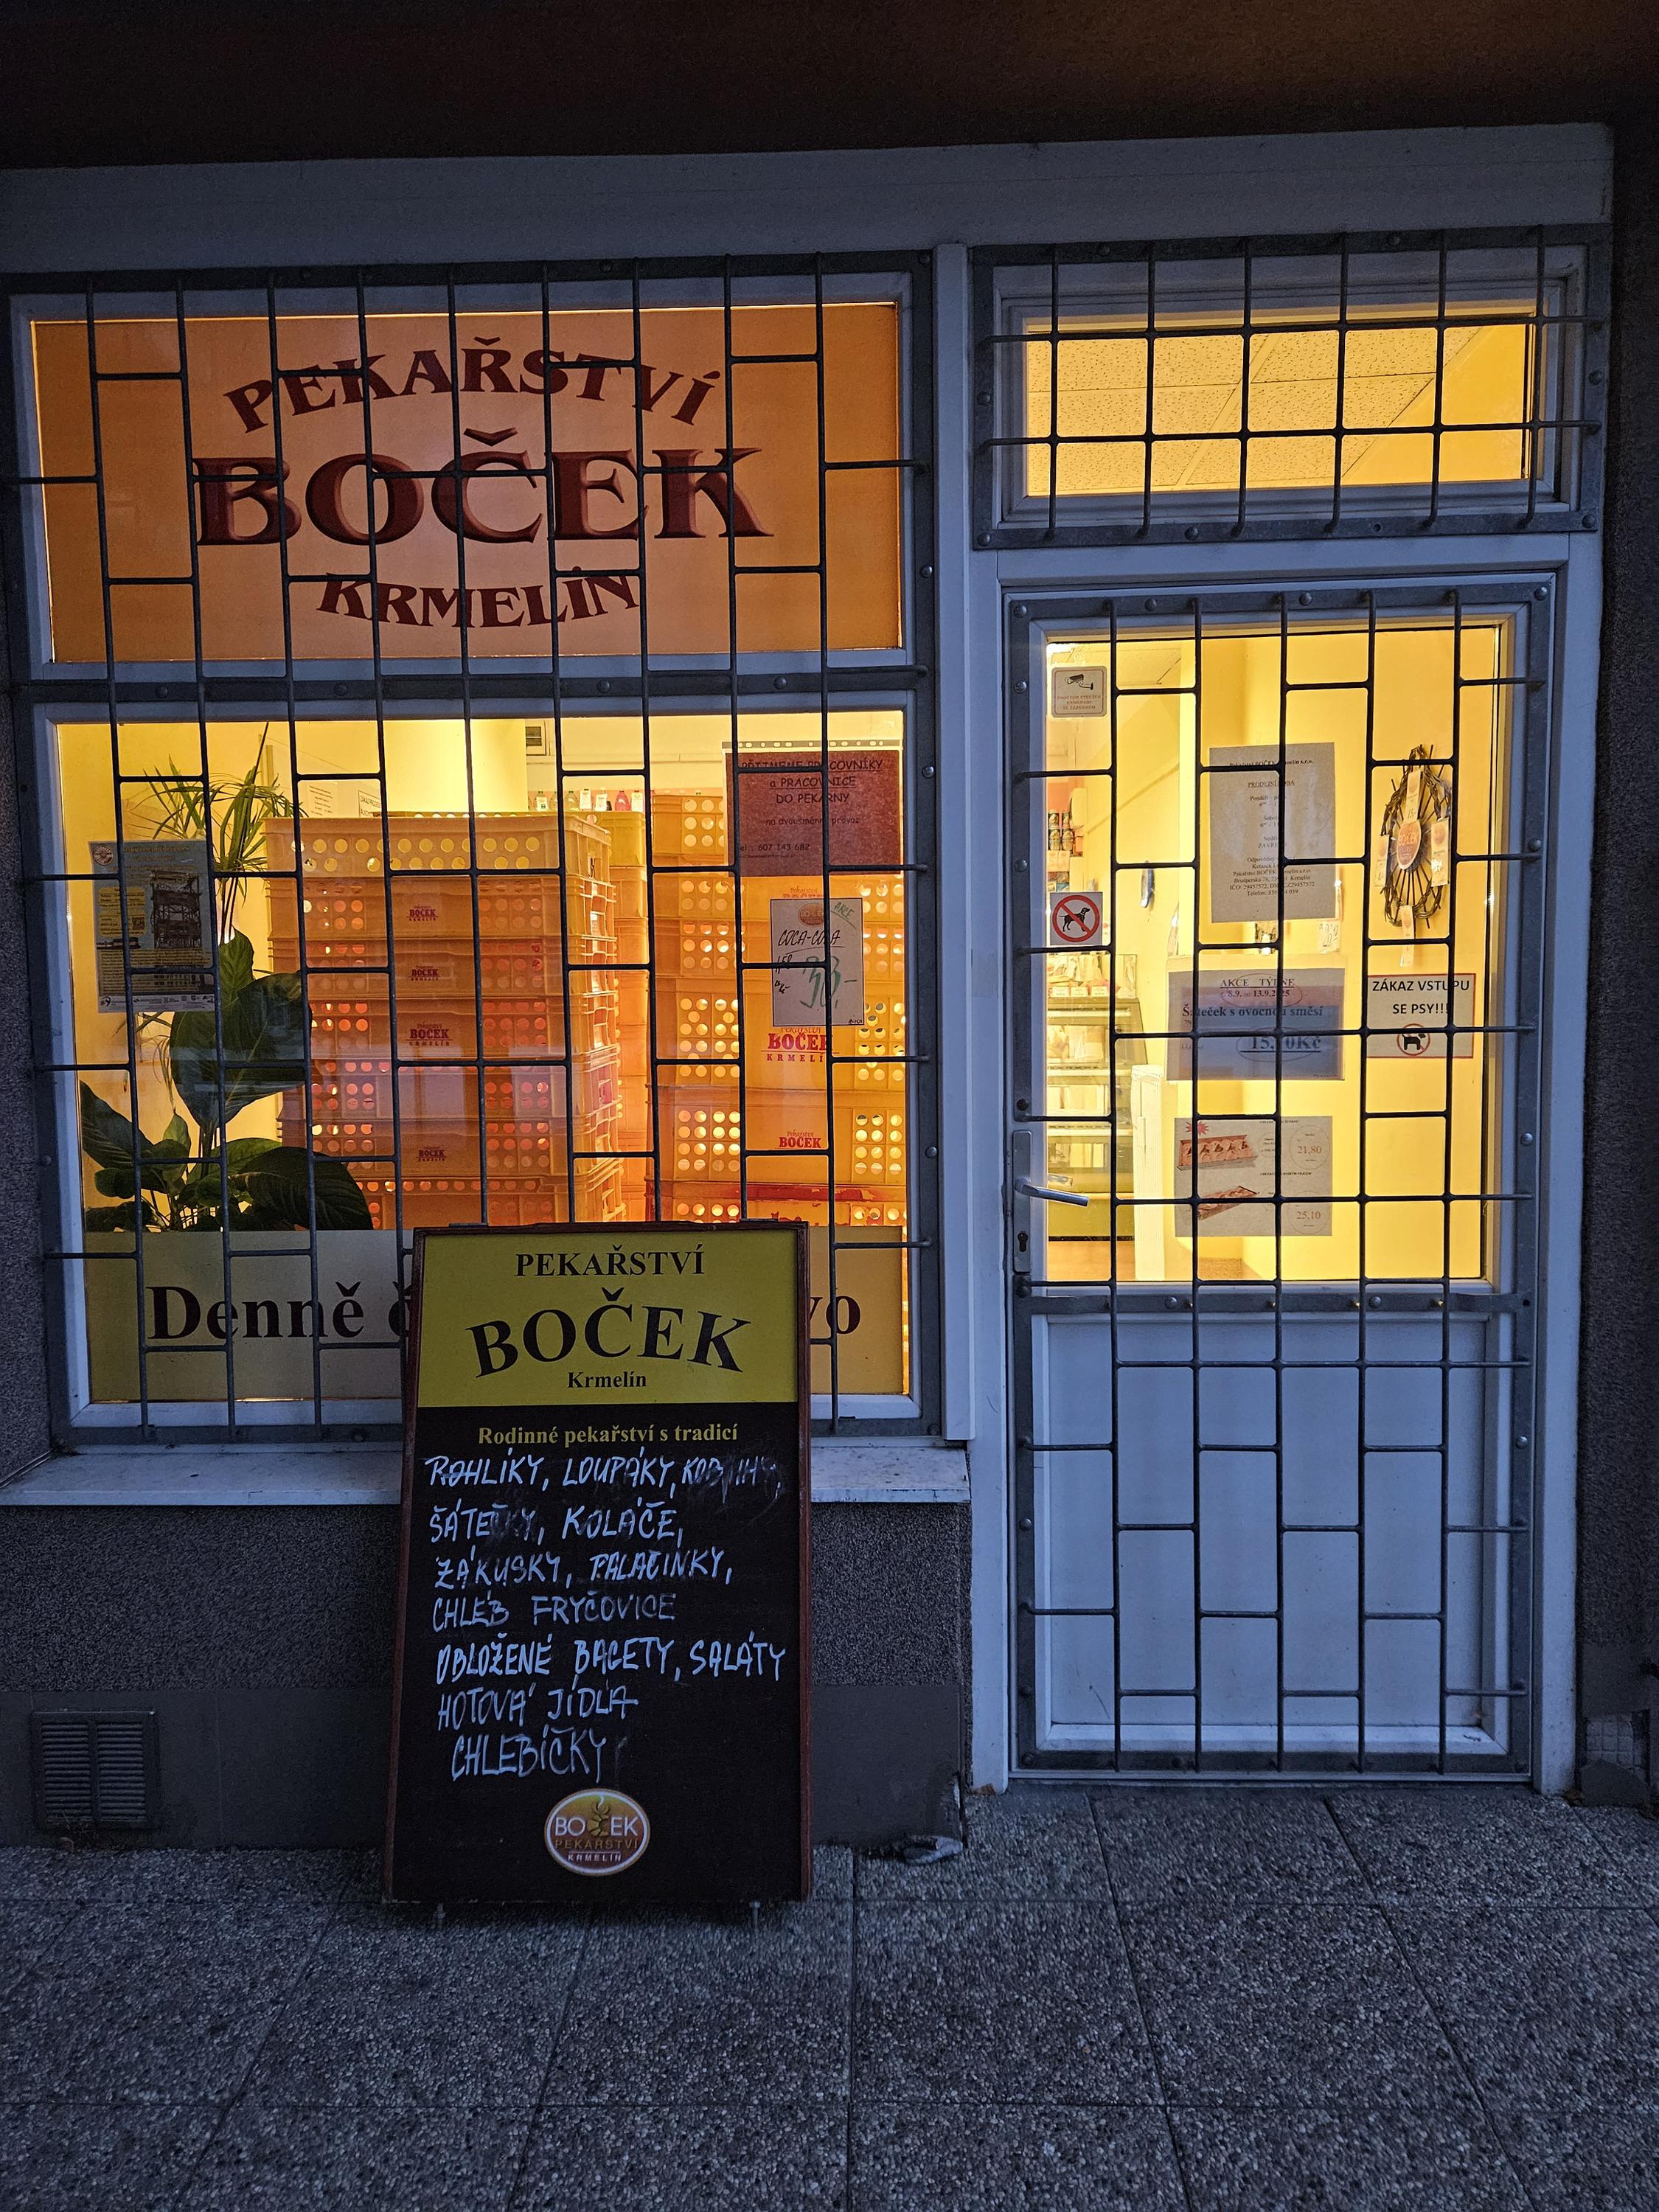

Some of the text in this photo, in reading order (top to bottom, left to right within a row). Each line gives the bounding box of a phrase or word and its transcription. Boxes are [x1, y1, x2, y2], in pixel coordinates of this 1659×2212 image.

[223, 336, 720, 434] PEKAŘSTVÍ
[193, 427, 775, 546] BOČEK
[318, 566, 639, 628] KRMELÍN
[808, 757, 883, 770] PRCOVNÍKY
[776, 794, 793, 804] DO
[832, 817, 860, 826] provoz
[834, 902, 855, 919] AKCE
[778, 929, 841, 946] COCA-COA
[1220, 976, 1295, 987] AKCE TÝNE
[1372, 978, 1470, 991] ZÁKAZ VSTUPU
[1183, 1003, 1226, 1017] Šteček
[1229, 1008, 1235, 1016] s
[1290, 1006, 1324, 1017] směsí
[1392, 1004, 1407, 1014] SE
[767, 1053, 824, 1062] KRMELÍ
[779, 1135, 821, 1148] BOČEK
[1298, 1145, 1322, 1155] 21,80
[1297, 1211, 1321, 1220] 25,10
[515, 1244, 706, 1276] PEKAŘSTVÍ
[145, 1281, 365, 1340] Denně
[465, 1287, 751, 1378] BOČEK
[567, 1370, 647, 1388] Krmelín
[479, 1424, 738, 1448] Rodinné pekařství s tradicí
[425, 1447, 549, 1491] ROHLÍKY,
[563, 1447, 675, 1498] LOUPÁKY,
[563, 1497, 684, 1548] KOLÁČE,
[531, 1590, 677, 1625] FRYČOVICE
[436, 1632, 554, 1685] OBLOŽENÉ
[689, 1631, 786, 1682] SALÁTY
[438, 1683, 537, 1731] HOTOVÁ
[451, 1723, 607, 1784] CHLEBÍČKY
